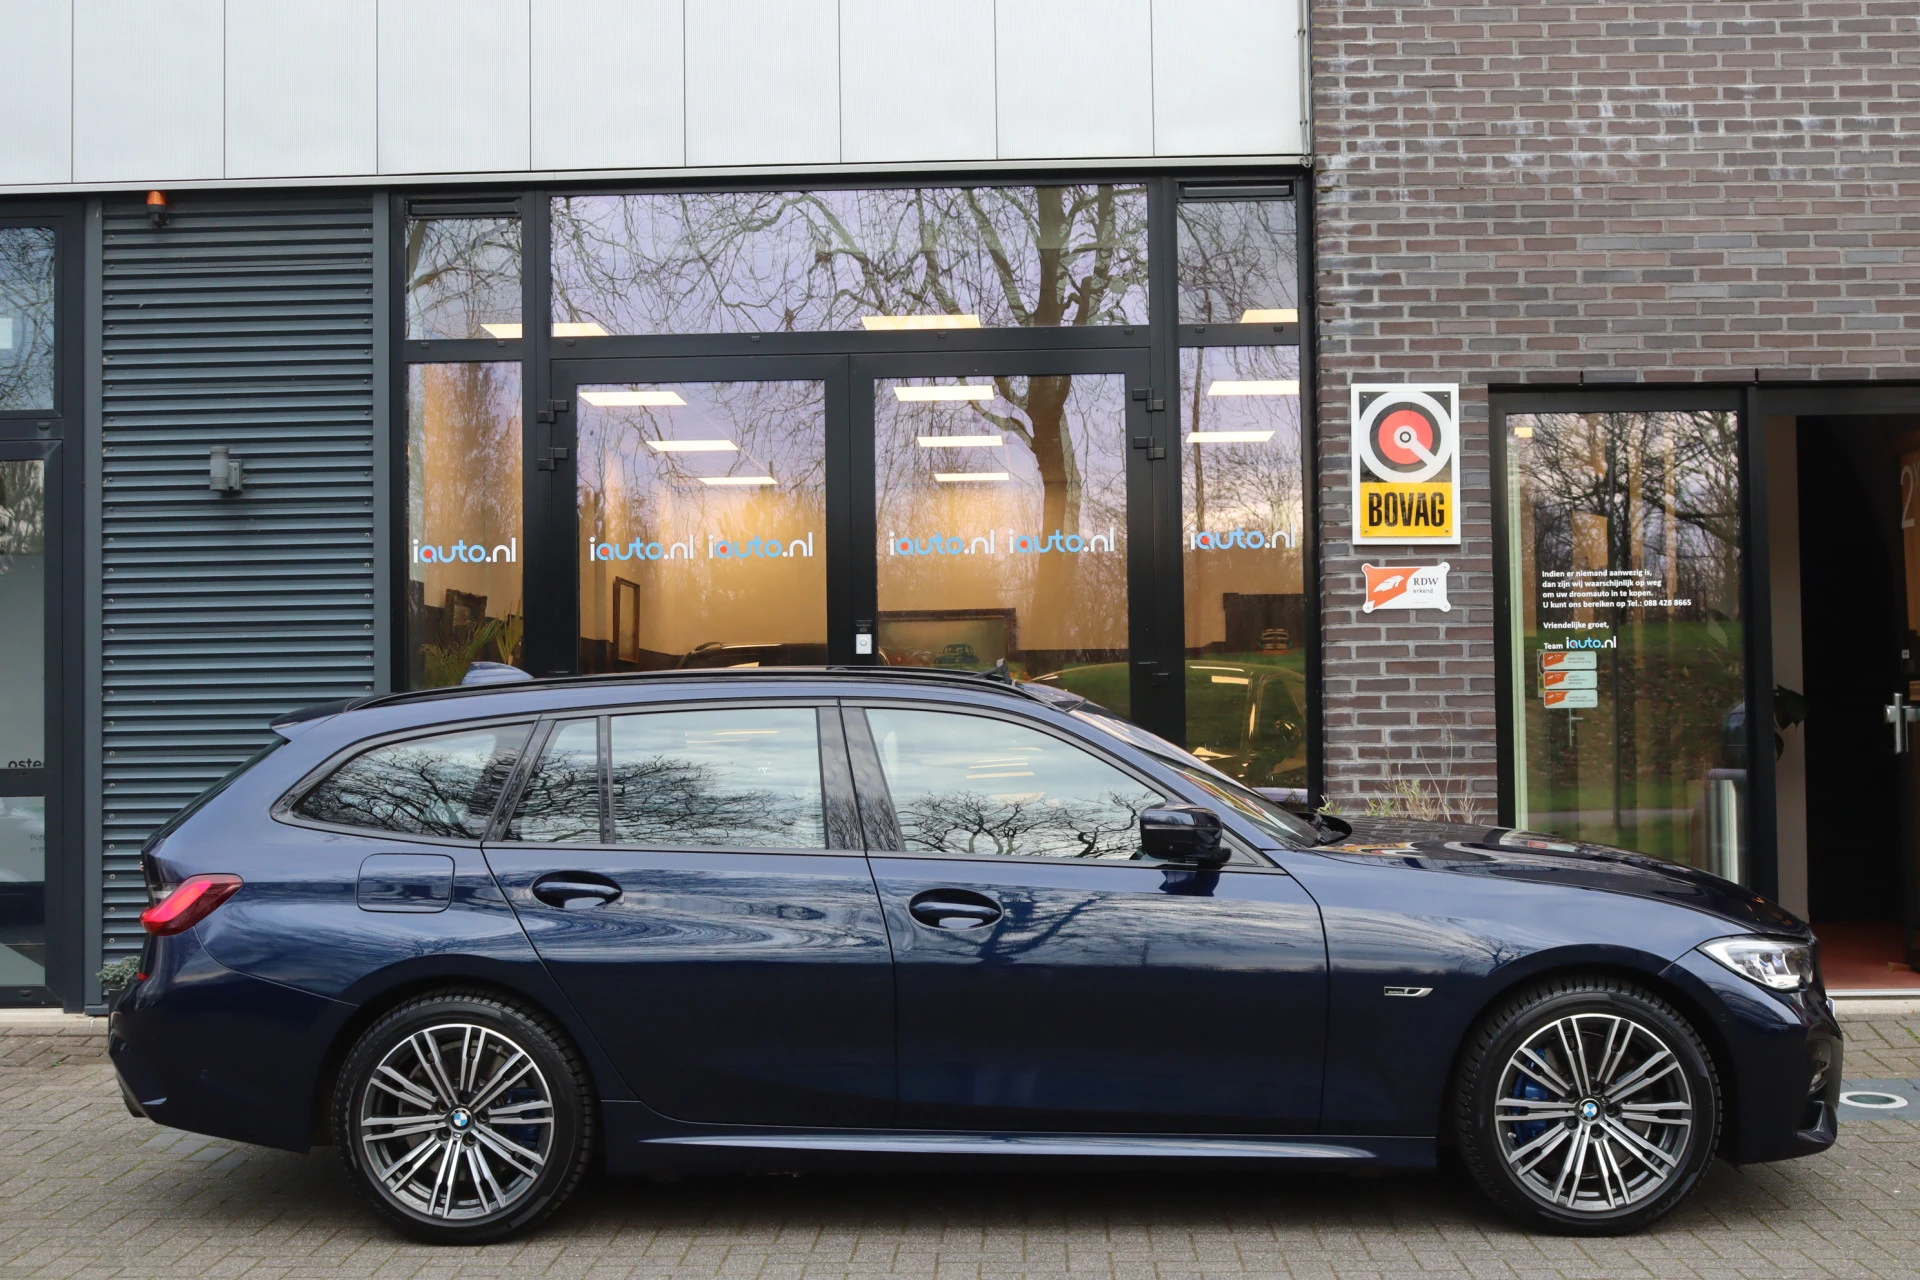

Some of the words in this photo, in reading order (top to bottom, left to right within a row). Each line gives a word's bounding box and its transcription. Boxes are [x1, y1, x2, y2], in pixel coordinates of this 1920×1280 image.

[1368, 491, 1445, 527] BOVAG
[889, 529, 995, 556] iauto.nl
[1008, 527, 1115, 554] iauto.nl
[1189, 523, 1296, 550] iauto.nl
[412, 537, 517, 564] iauto.nl
[589, 534, 694, 562] iauto.nl
[708, 531, 813, 559] iauto.nl
[1609, 569, 1643, 577] aanwezig
[1413, 577, 1439, 586] RDW
[1558, 581, 1571, 589] zijn
[1572, 580, 1583, 588] wij
[1584, 579, 1634, 588] waarschijnlijk
[1629, 589, 1654, 597] kopen.
[1543, 622, 1586, 630] Vriendelijke
[1588, 621, 1610, 630] groet,
[1566, 636, 1616, 648] iauto.nl
